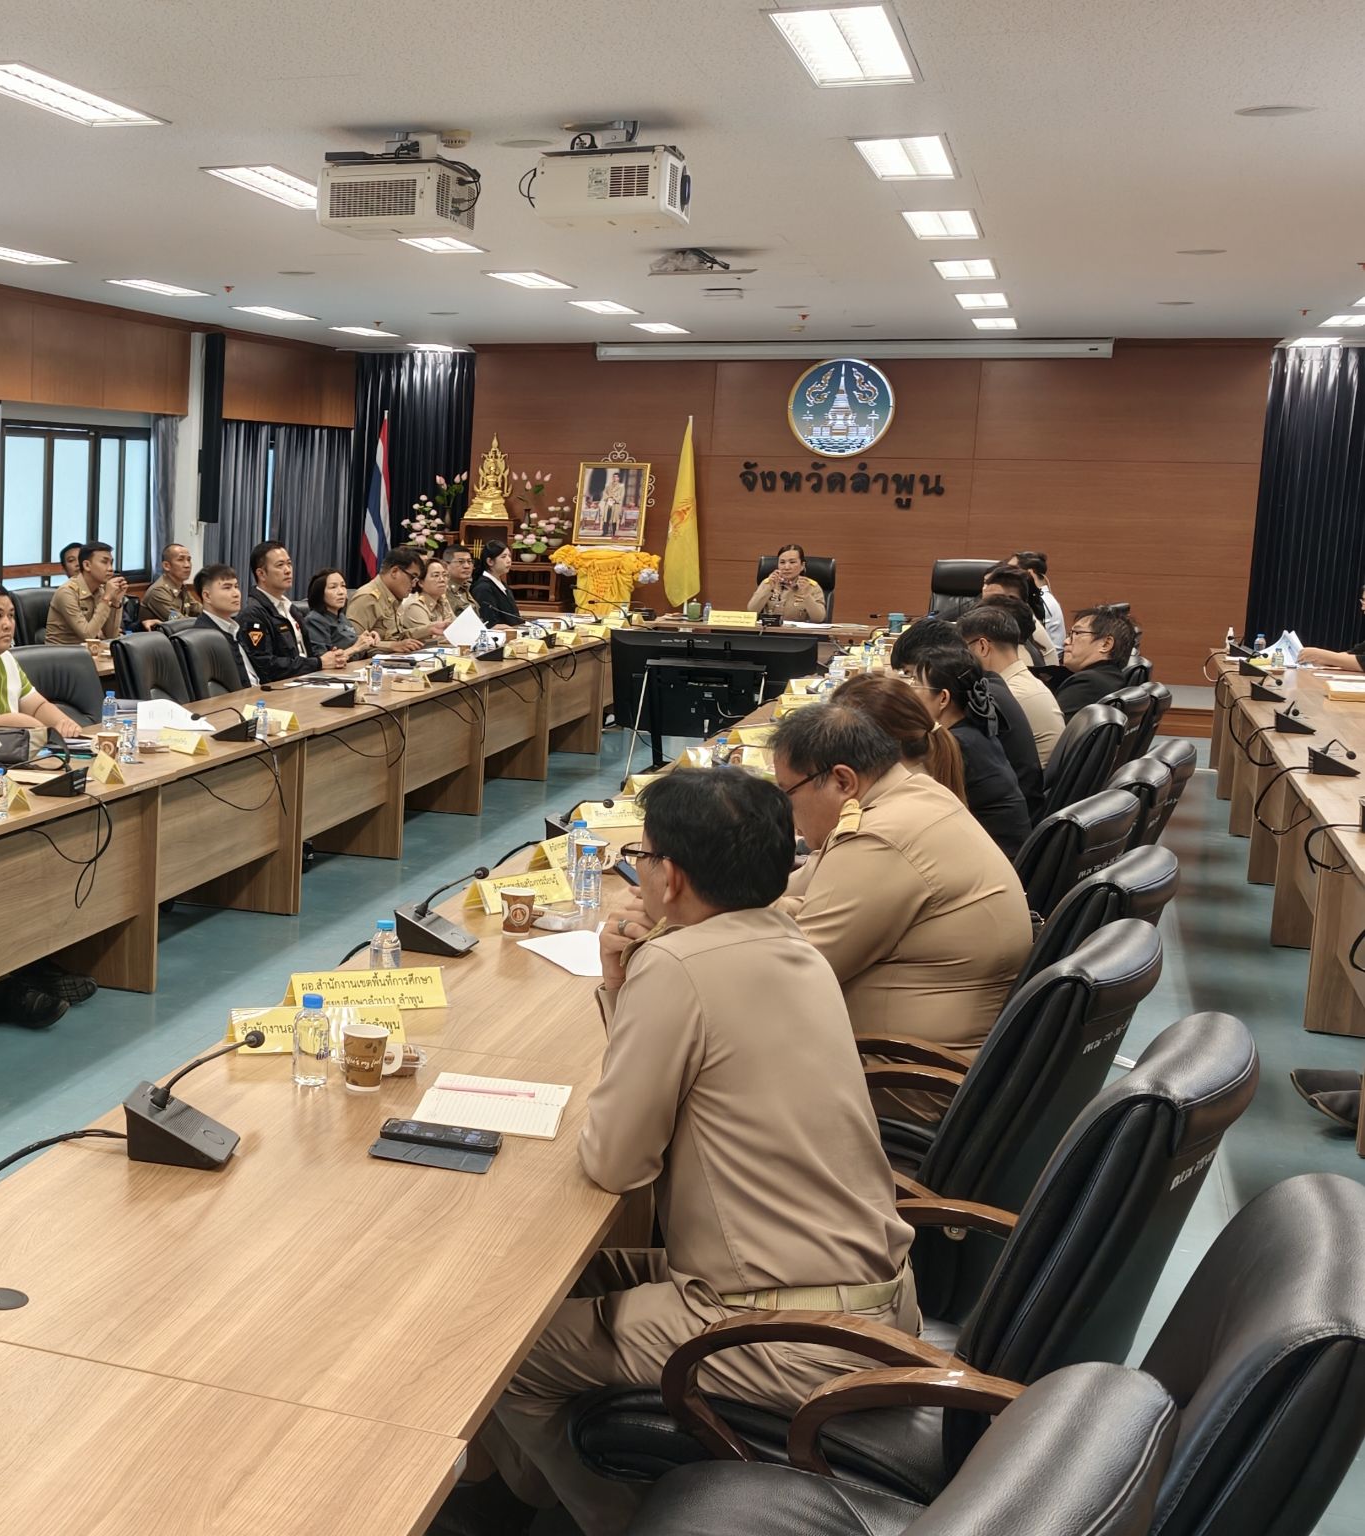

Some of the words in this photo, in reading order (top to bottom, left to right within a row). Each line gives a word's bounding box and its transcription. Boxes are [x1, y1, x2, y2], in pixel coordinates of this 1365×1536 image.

[739, 461, 945, 509] จังหวัดลำพูน
[301, 971, 433, 992] ผอ.สำนักงานเขตพื้นที่การศึกษา
[398, 993, 424, 1008] ลำพูน
